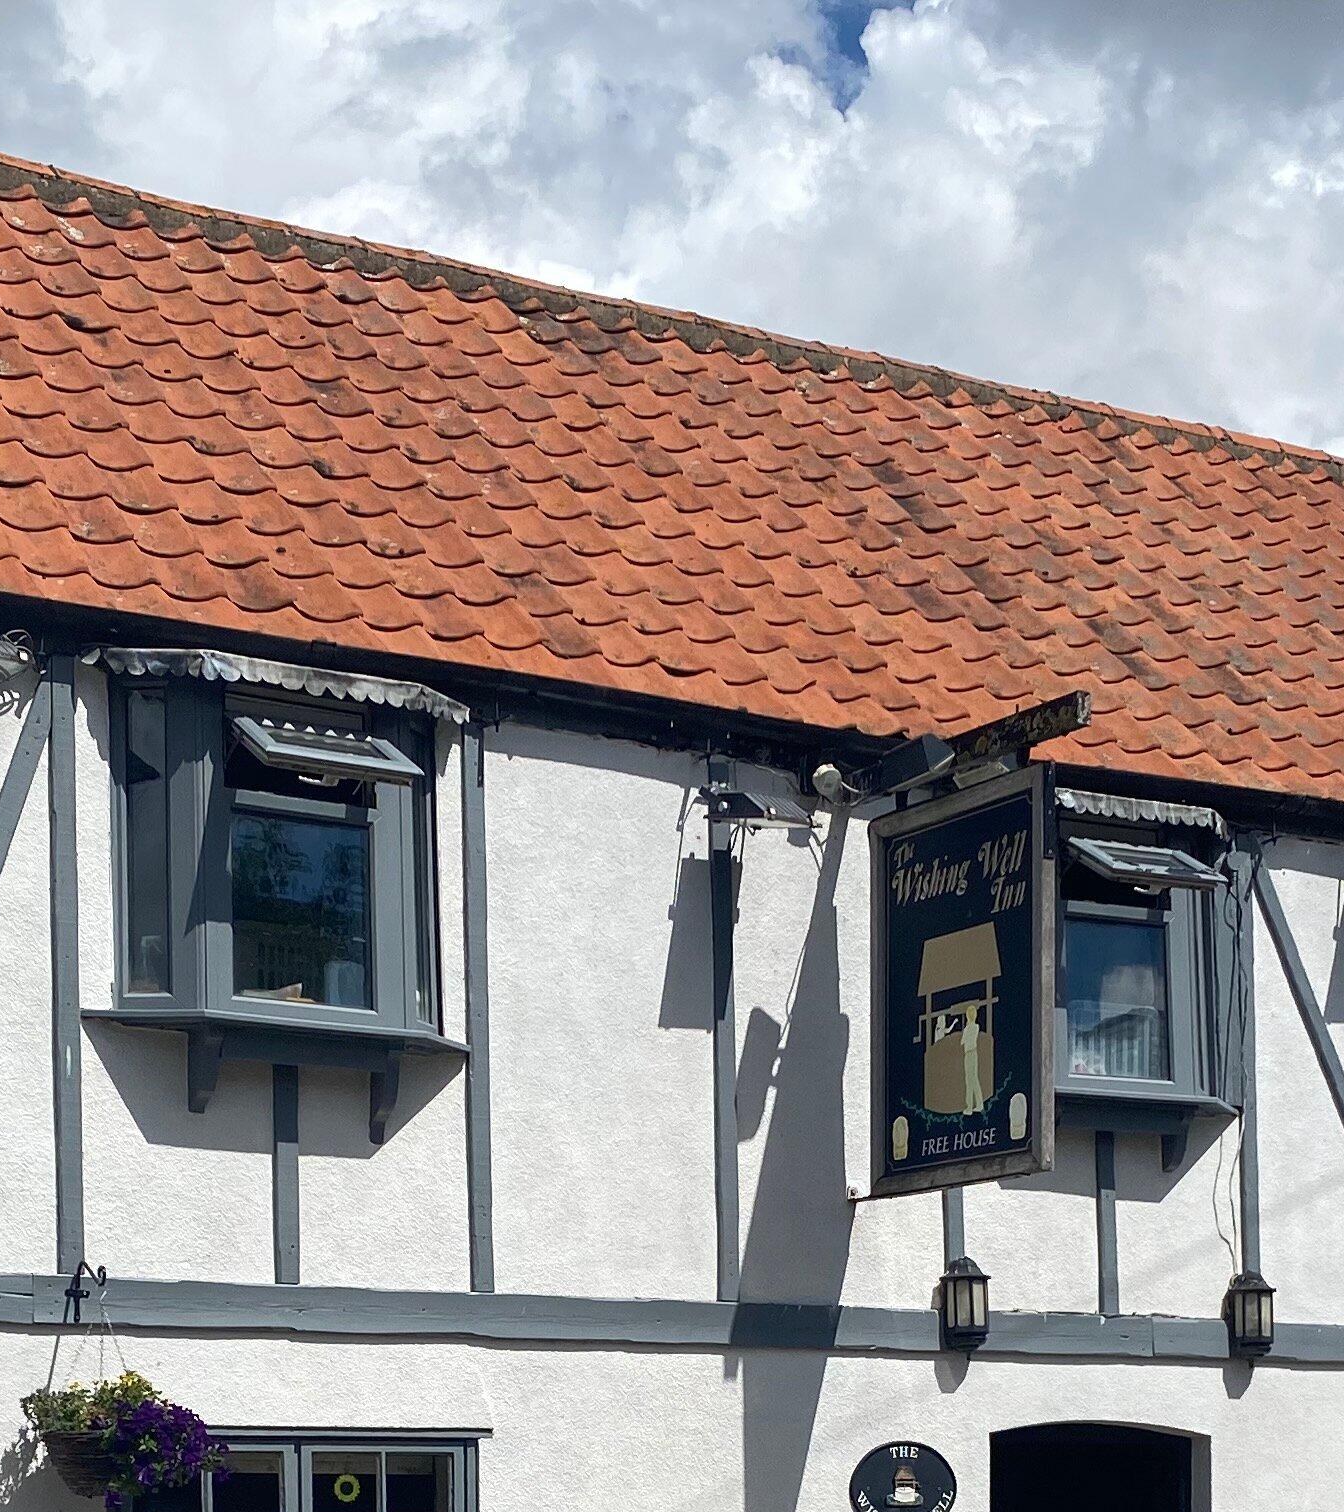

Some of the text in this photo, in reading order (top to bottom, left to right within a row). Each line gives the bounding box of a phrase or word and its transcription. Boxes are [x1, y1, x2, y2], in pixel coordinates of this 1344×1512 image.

[891, 829, 1027, 907] Wishing Well
[990, 876, 1026, 914] Inn
[921, 1127, 997, 1157] FREE HOUSE
[889, 1445, 920, 1459] THE
